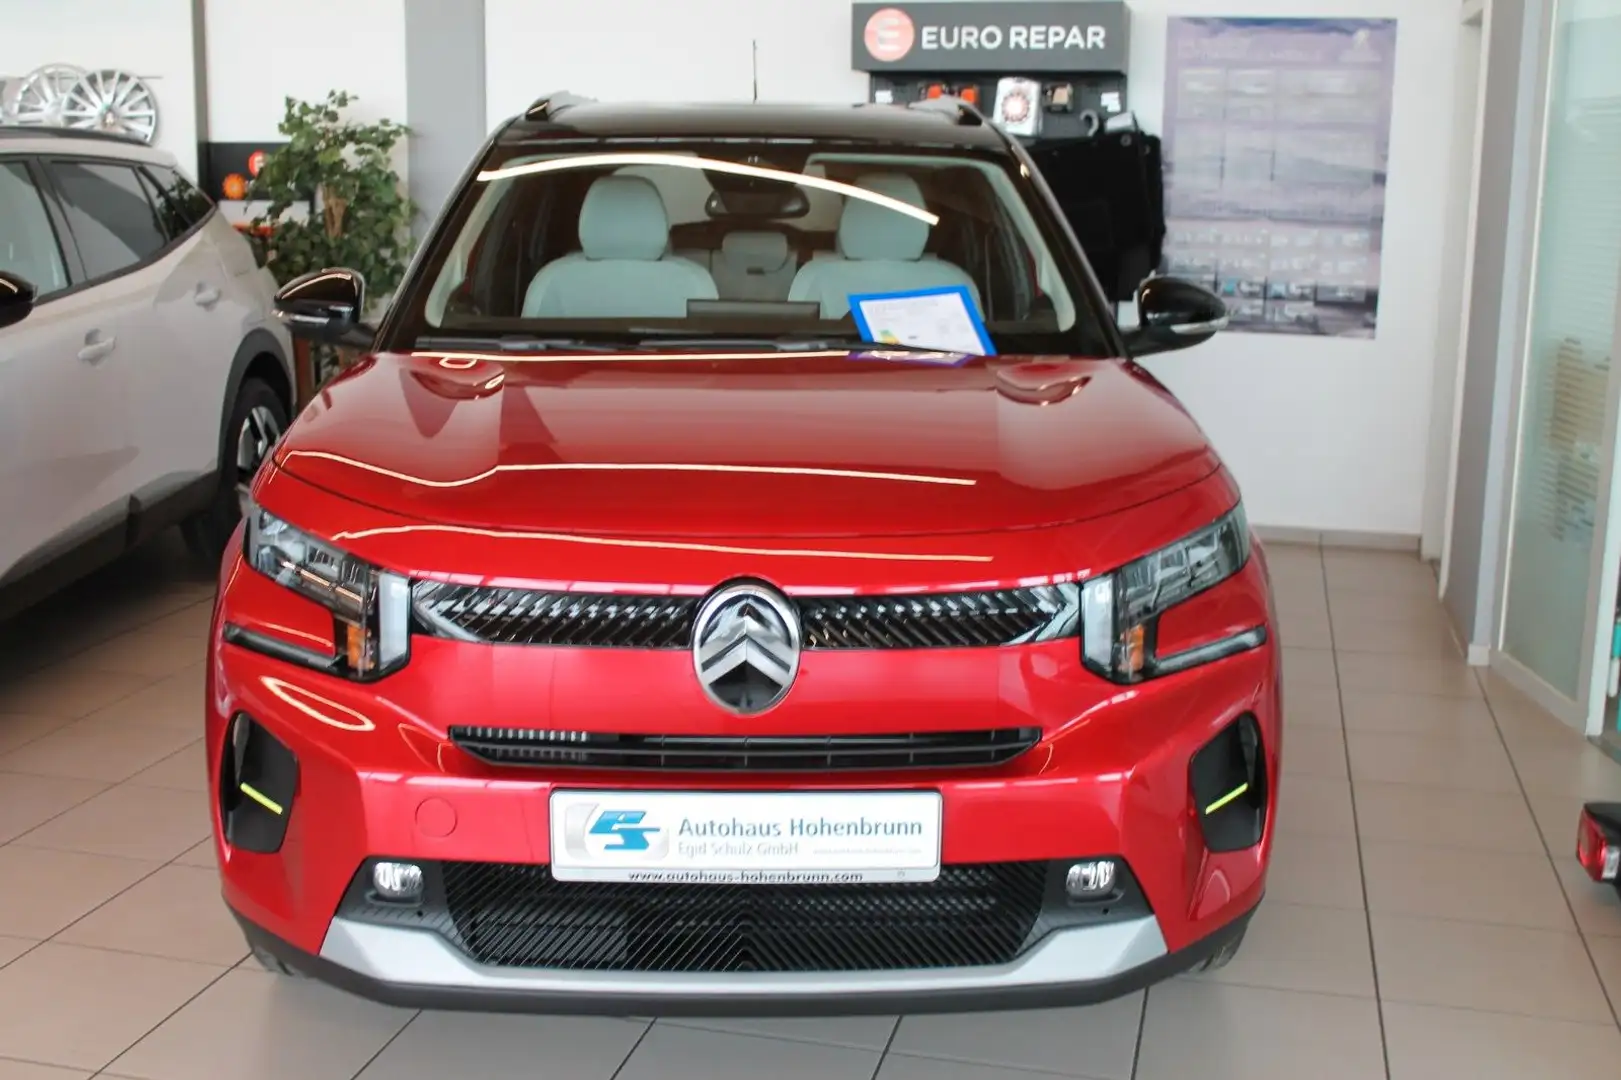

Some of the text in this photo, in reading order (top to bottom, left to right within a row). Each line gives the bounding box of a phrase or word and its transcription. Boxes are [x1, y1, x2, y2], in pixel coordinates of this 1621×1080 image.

[921, 25, 1003, 50] EURO
[1009, 25, 1107, 50] REPAR
[678, 817, 923, 837] Autohaus Hohenbrunn
[677, 841, 707, 859] Egid
[710, 841, 753, 856] Schulz
[756, 841, 799, 856] GmbH
[628, 869, 864, 883] www.autohaus-hohenbrunn.com
